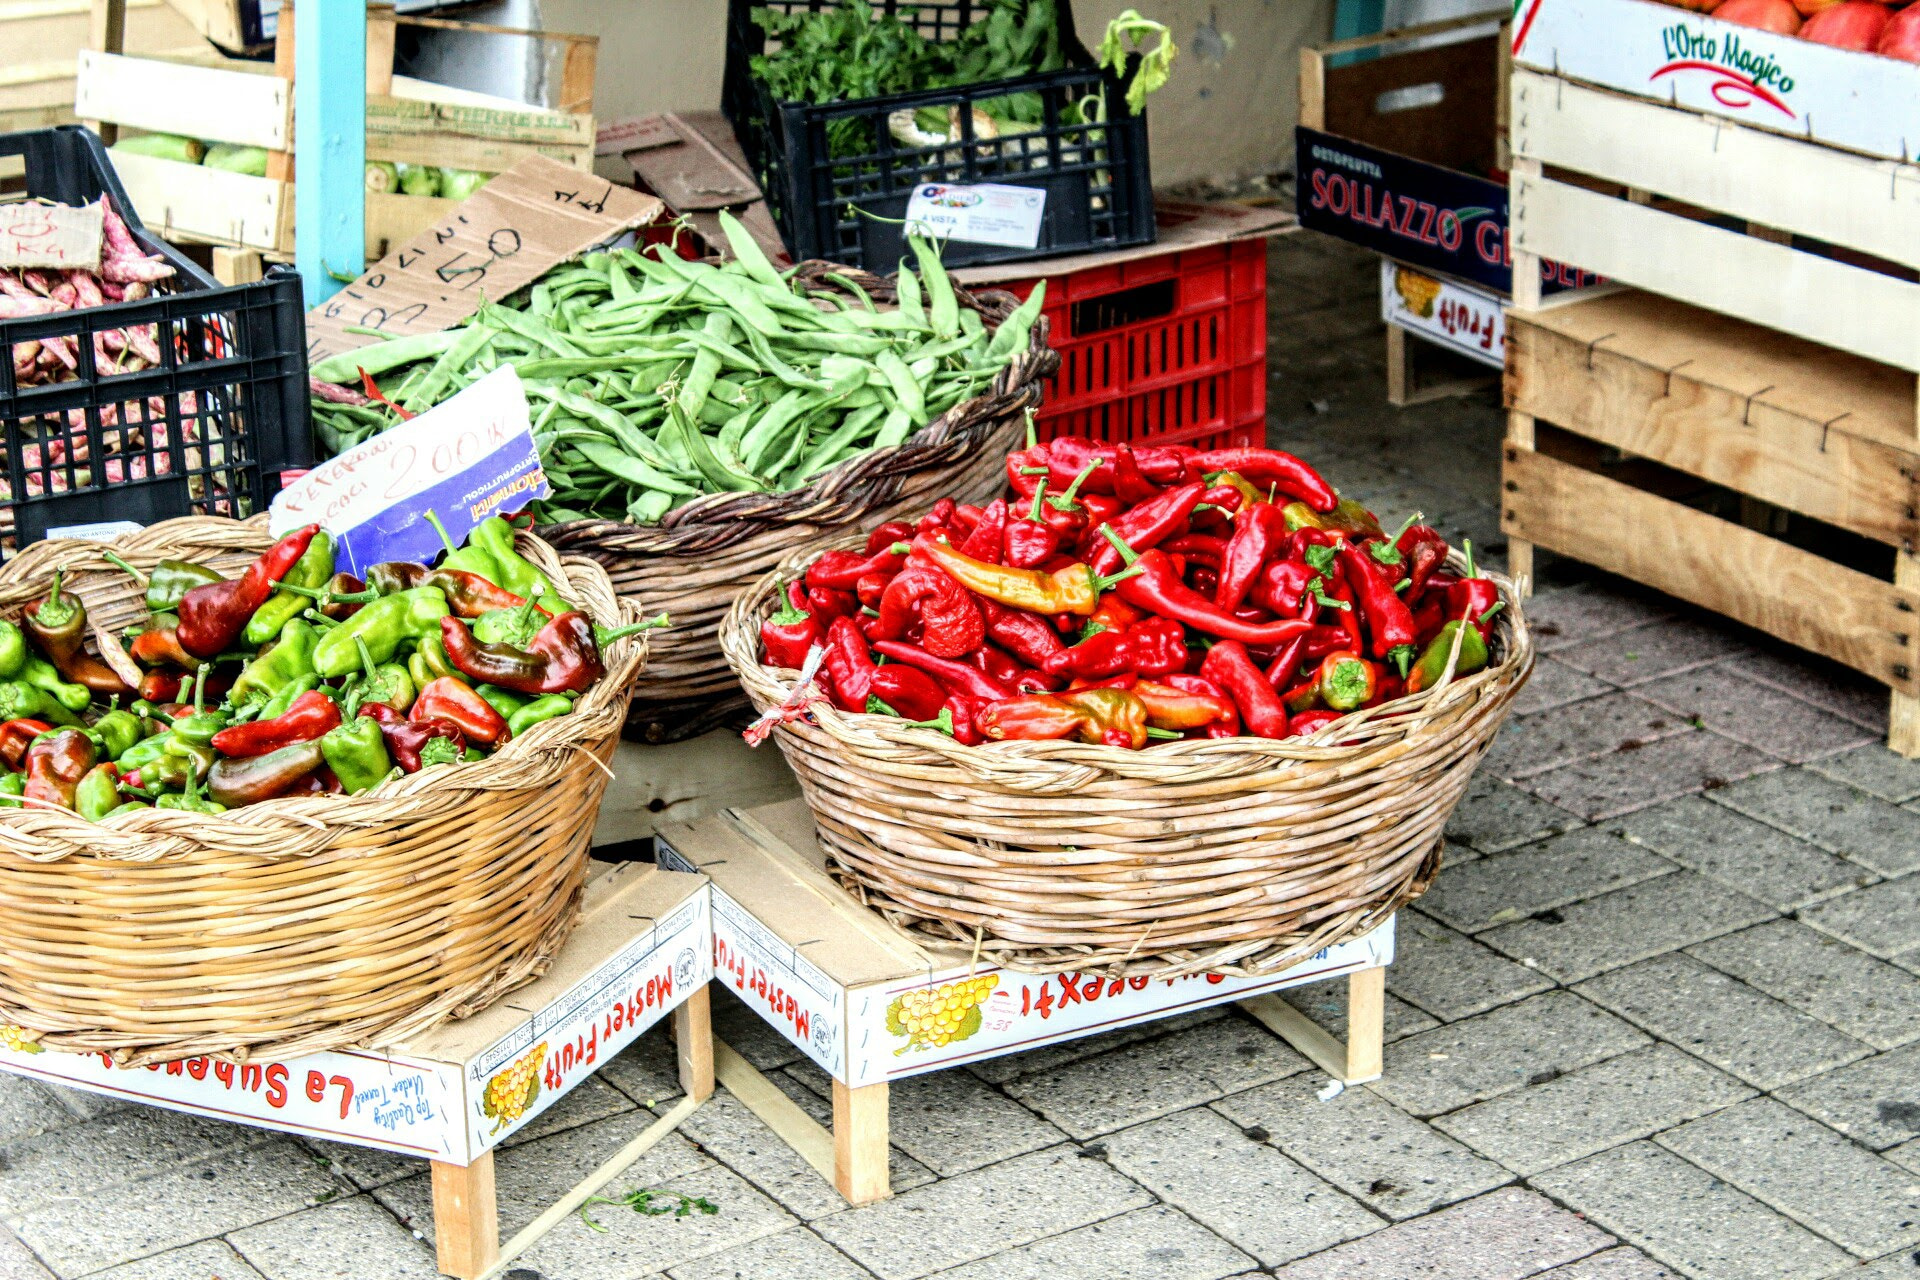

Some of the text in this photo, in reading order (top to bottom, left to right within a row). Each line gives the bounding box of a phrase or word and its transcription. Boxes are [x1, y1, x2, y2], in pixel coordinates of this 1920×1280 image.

[1662, 22, 1796, 93] L'Orto Magico
[1310, 167, 1464, 251] SOLLAZZO
[1438, 297, 1495, 350] Fruit
[462, 451, 540, 504] ORTOFRUTTICOLI
[713, 932, 745, 991] Frui
[544, 965, 673, 1091] Master Fruit
[750, 965, 809, 1043] Master
[305, 1070, 355, 1119] La
[391, 1074, 424, 1099] Under
[416, 1095, 435, 1121] Top
